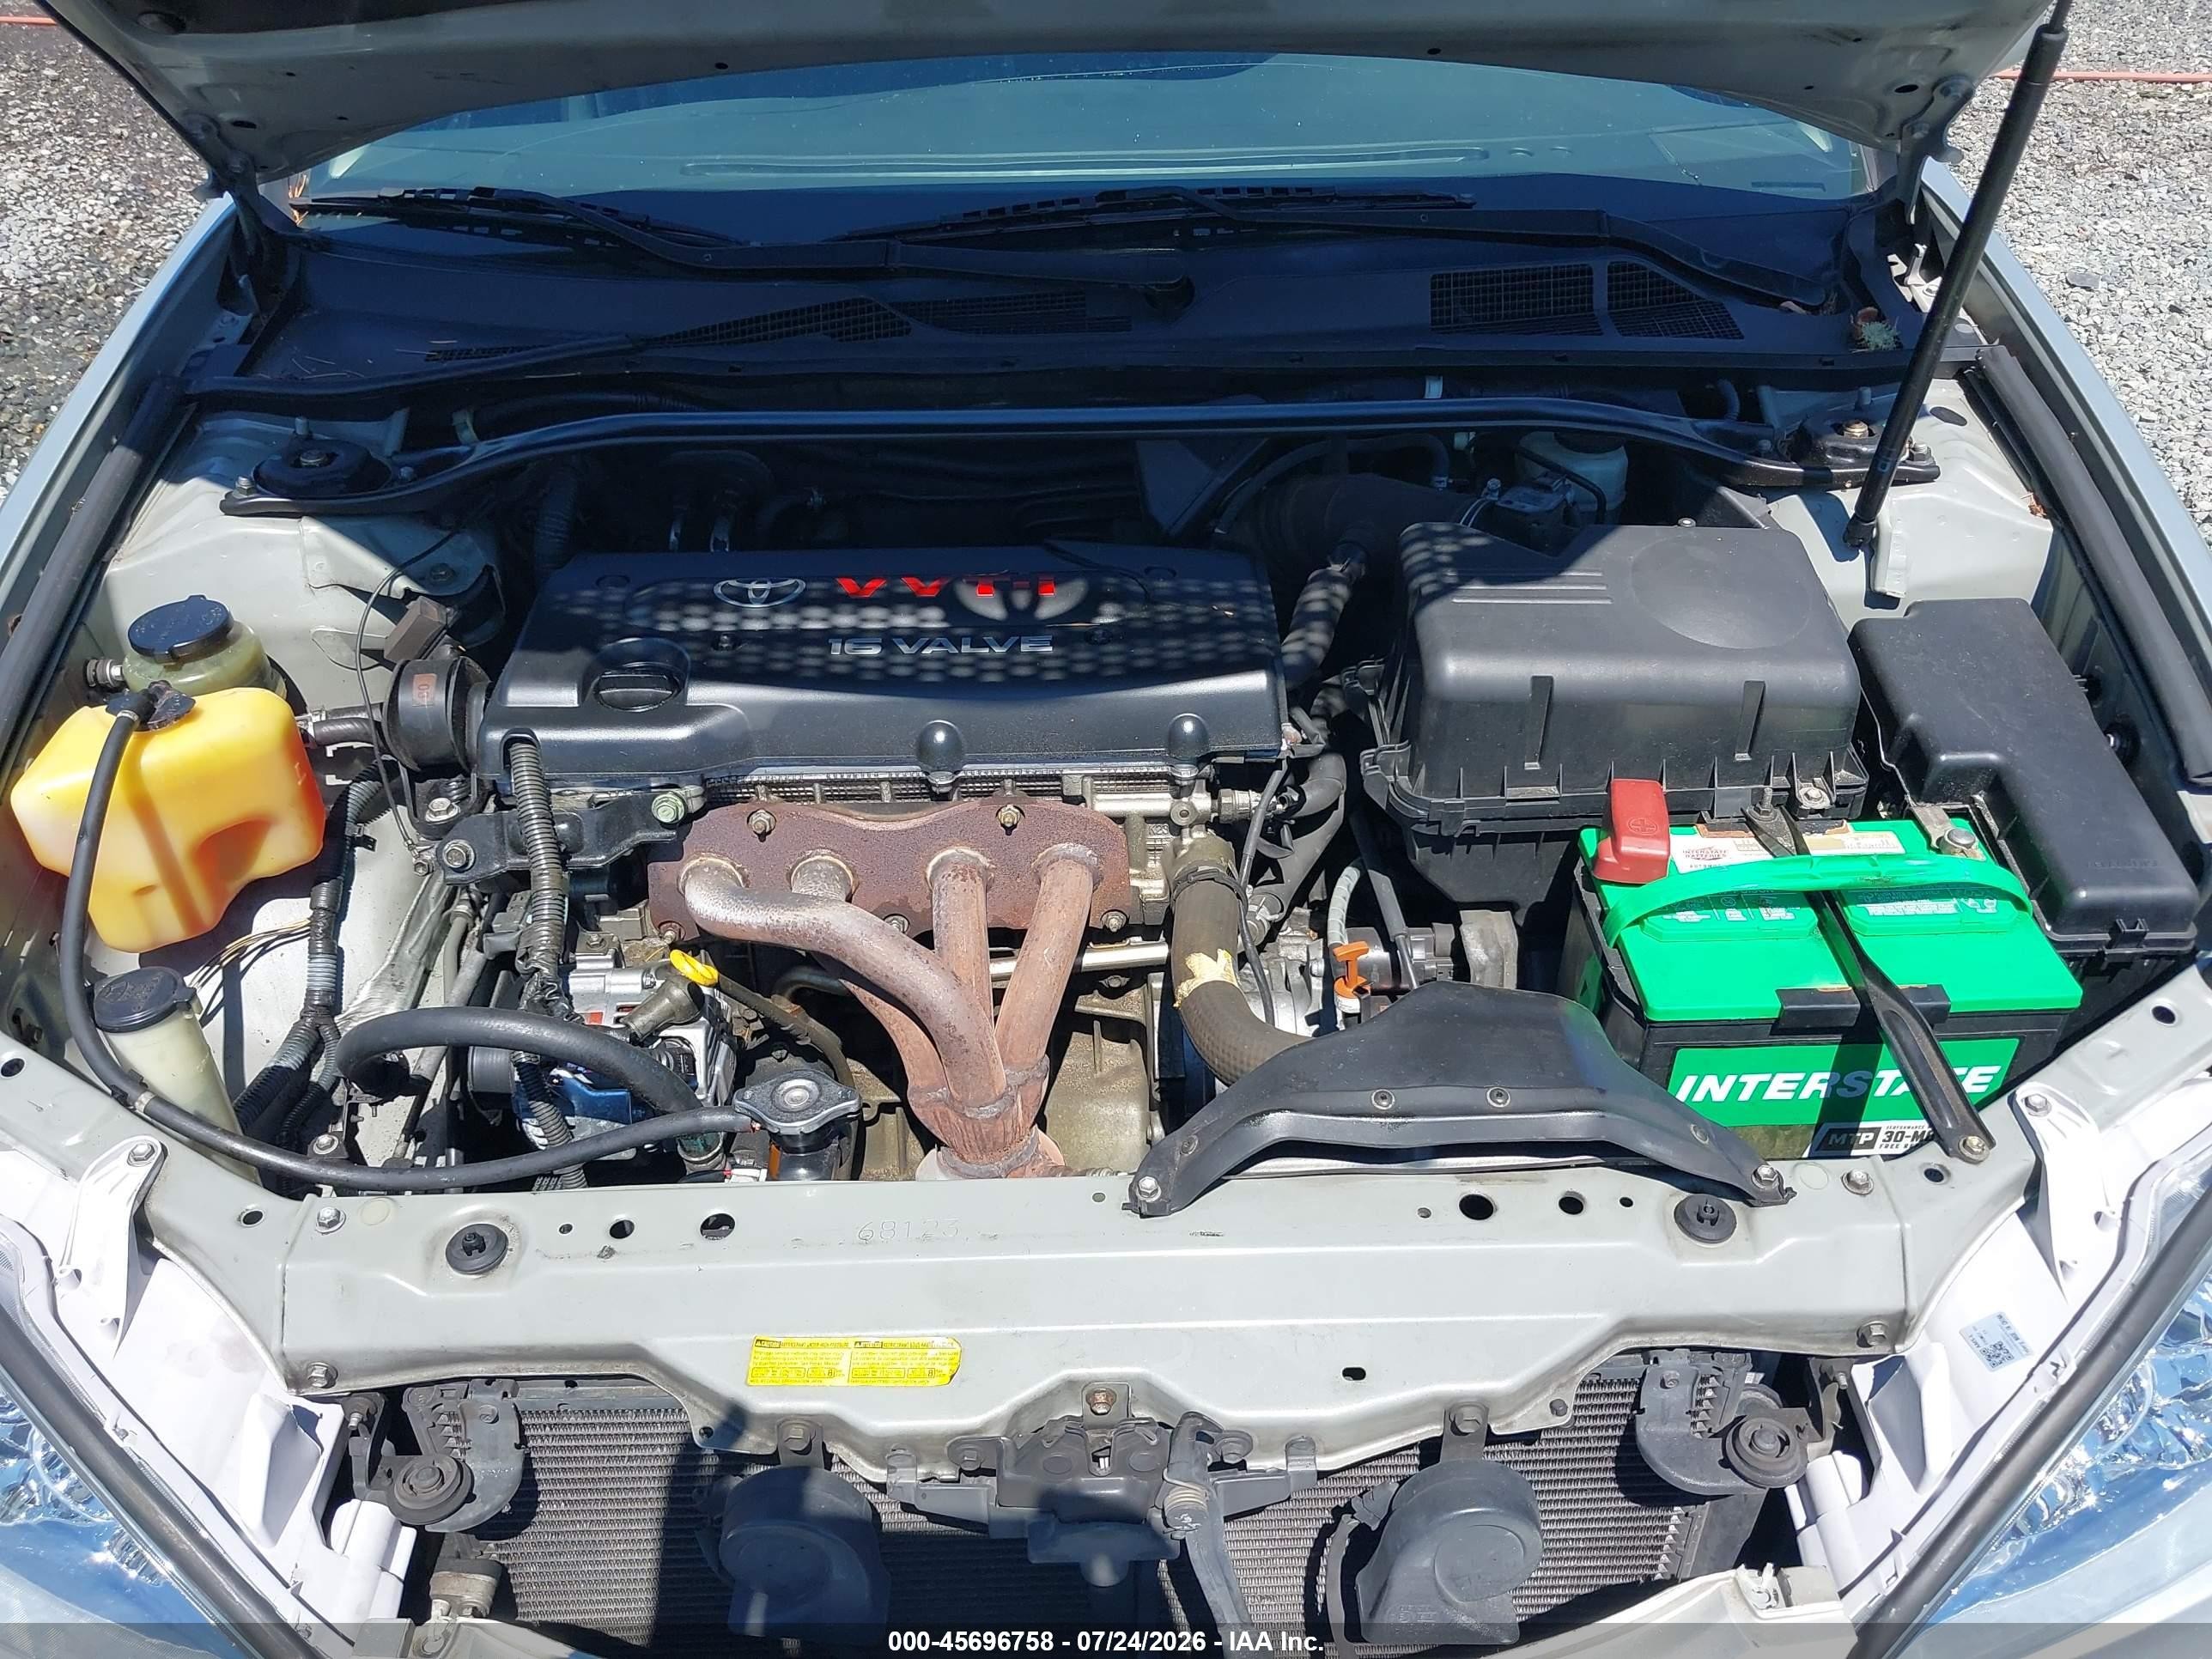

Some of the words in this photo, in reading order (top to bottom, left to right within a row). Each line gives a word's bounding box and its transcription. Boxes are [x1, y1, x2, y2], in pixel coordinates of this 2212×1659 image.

[828, 637, 883, 656] 16
[892, 635, 1054, 654] VALVE
[1828, 1132, 1875, 1146] MTP
